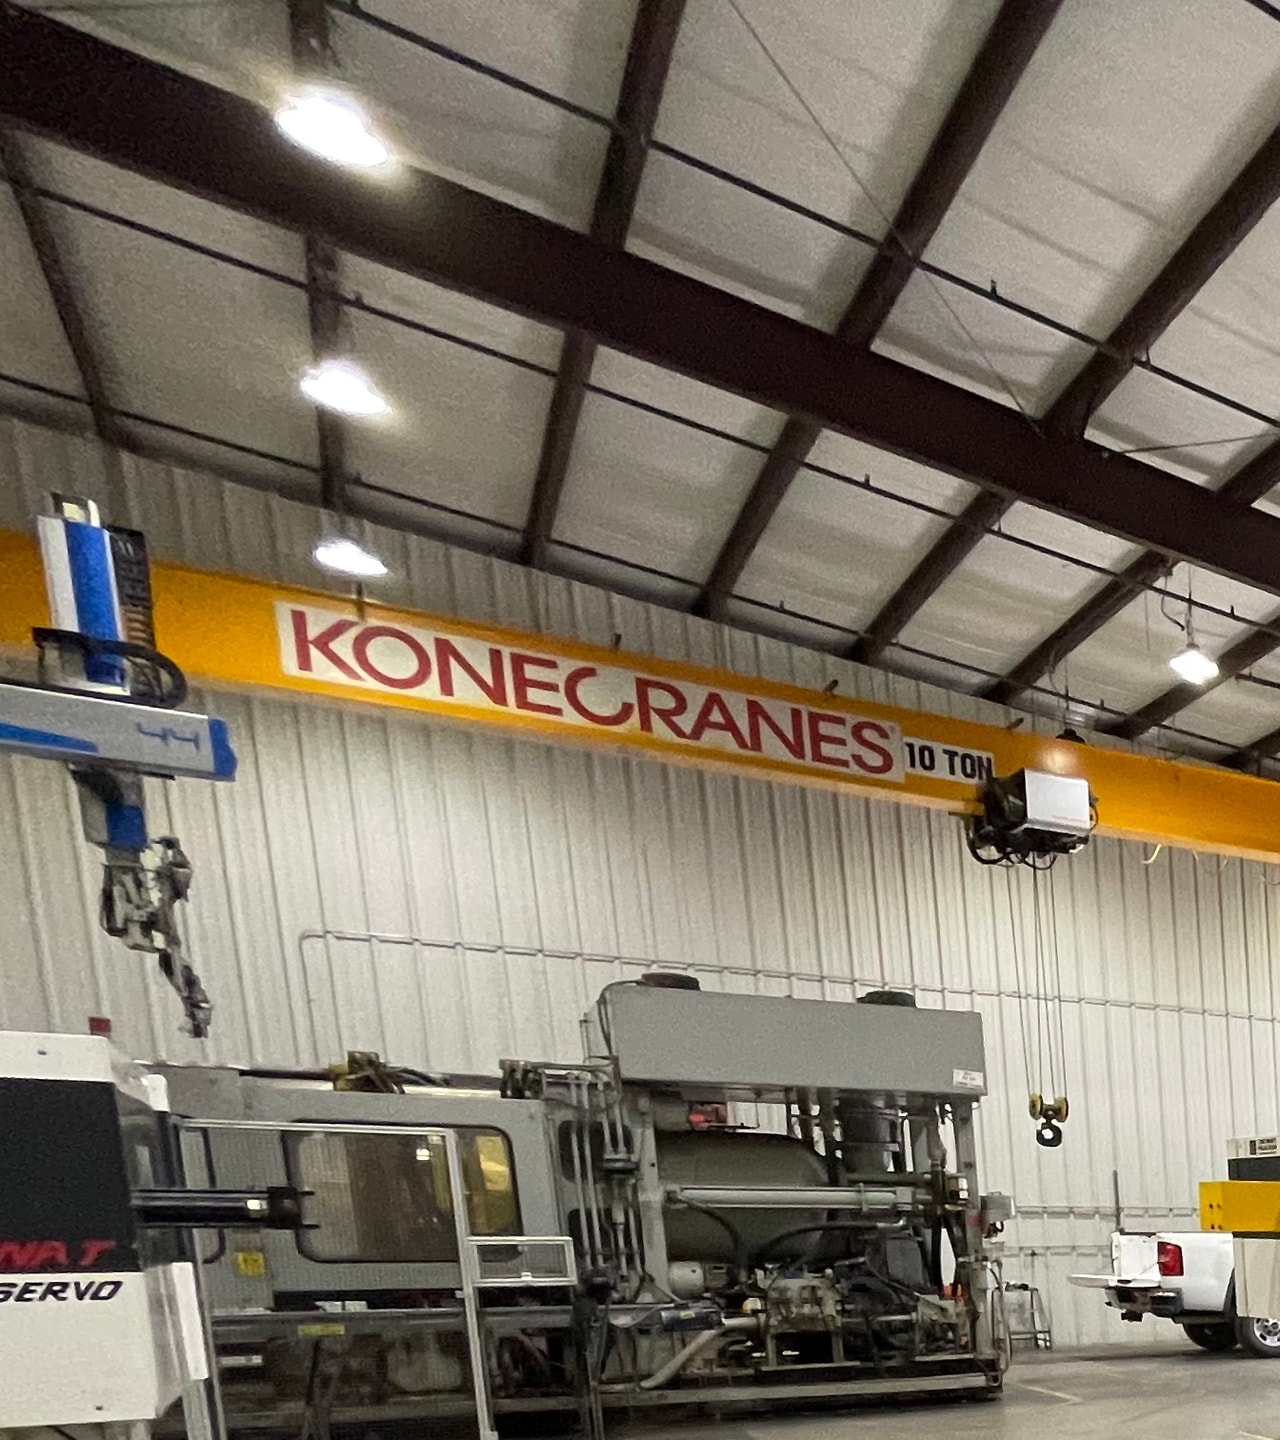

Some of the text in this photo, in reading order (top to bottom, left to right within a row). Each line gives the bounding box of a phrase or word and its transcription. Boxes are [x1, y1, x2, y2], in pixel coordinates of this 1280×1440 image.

[290, 609, 895, 775] KONECRANES
[905, 742, 993, 781] 10 TON
[0, 1281, 123, 1303] SERVO
